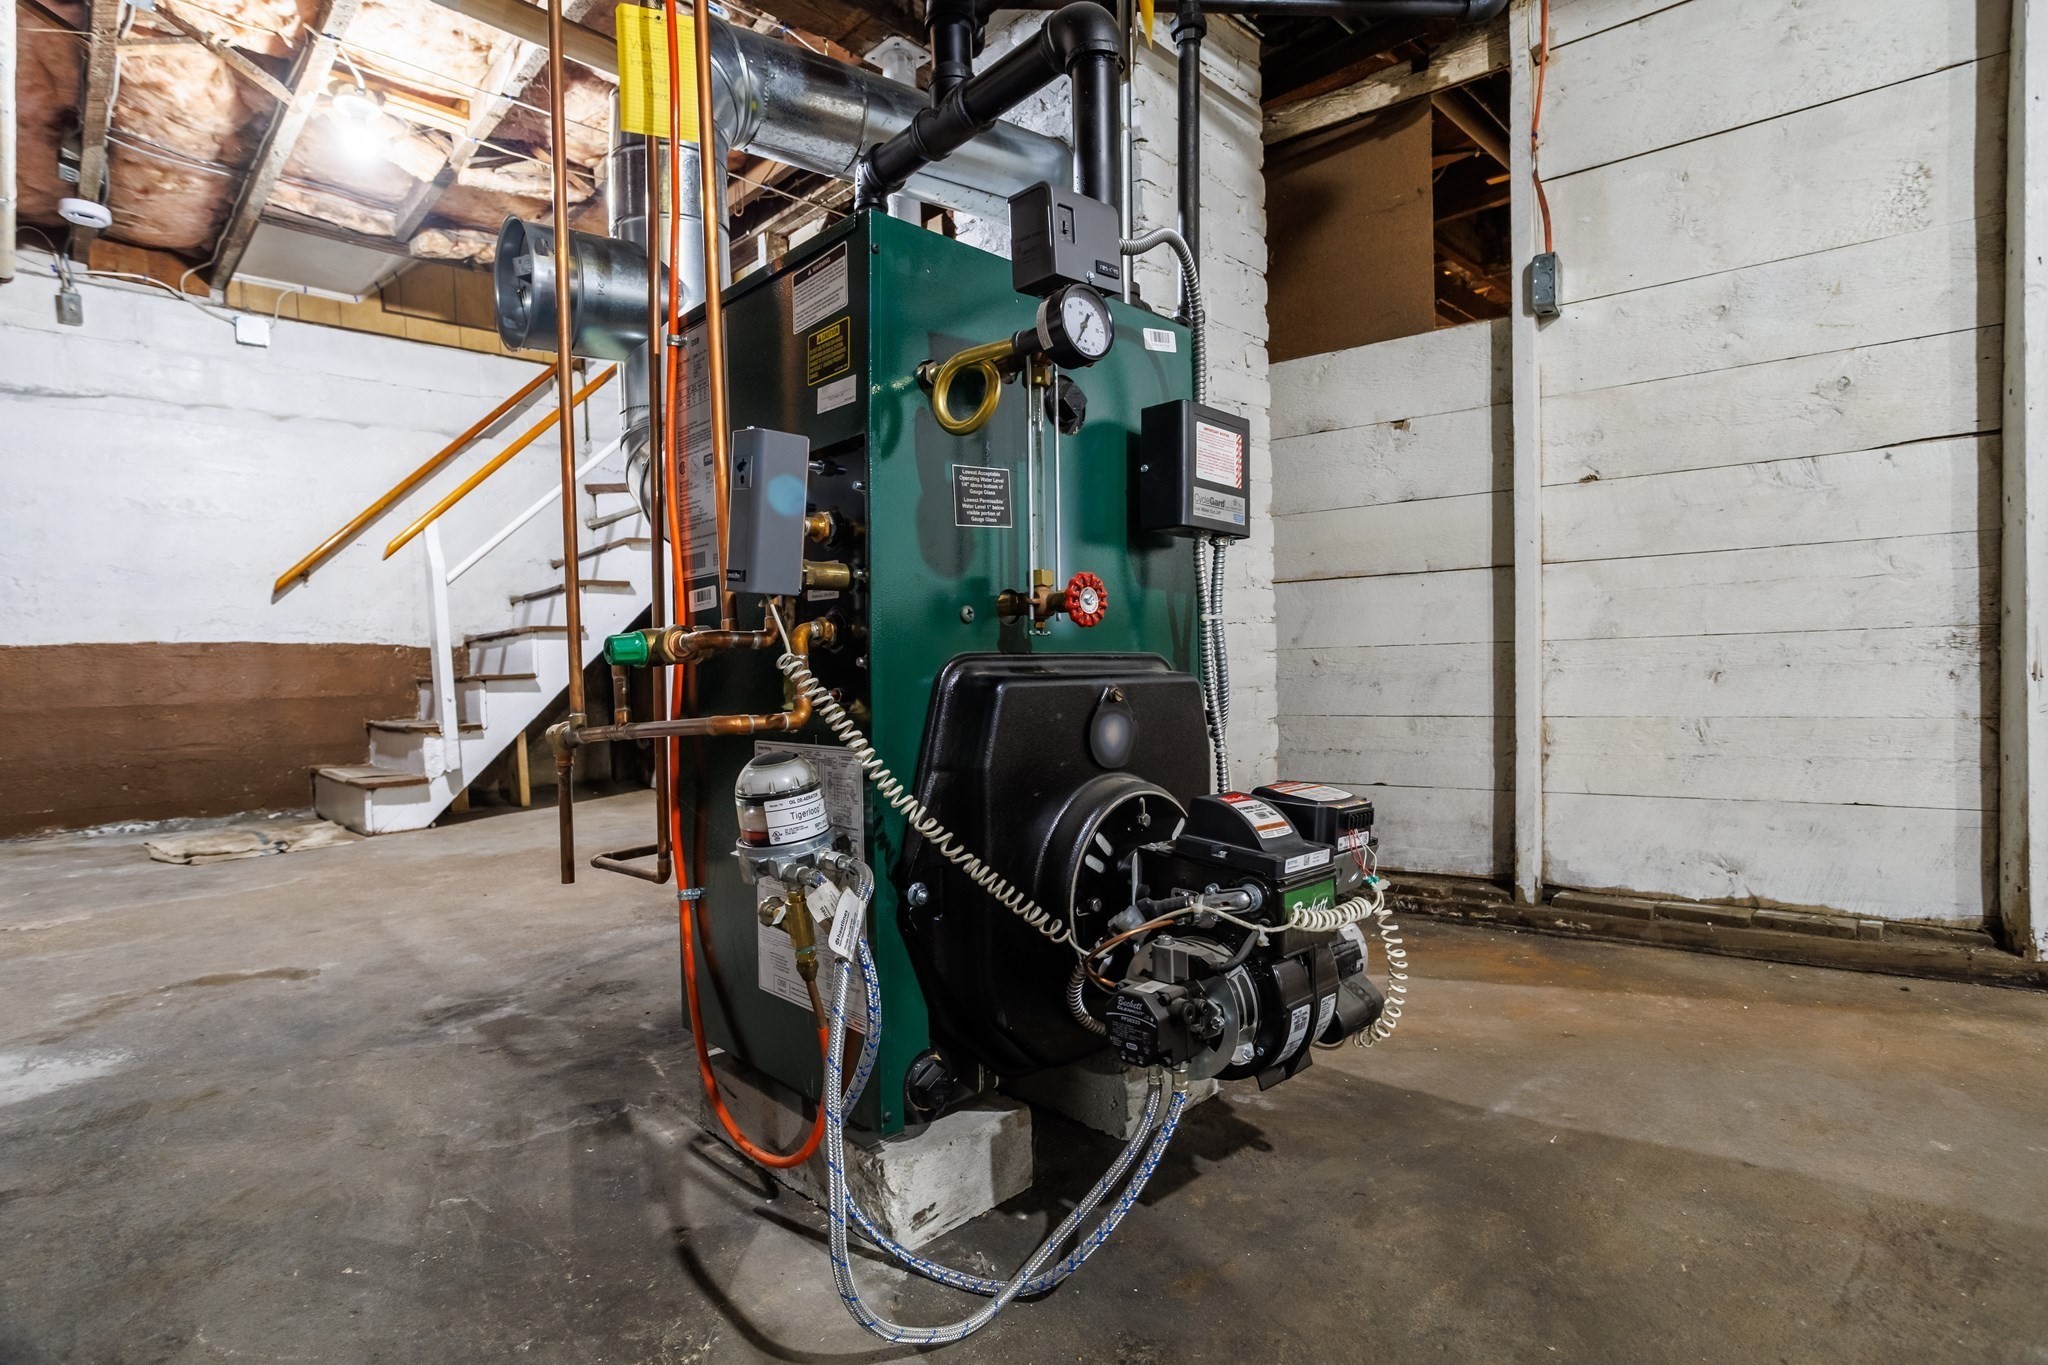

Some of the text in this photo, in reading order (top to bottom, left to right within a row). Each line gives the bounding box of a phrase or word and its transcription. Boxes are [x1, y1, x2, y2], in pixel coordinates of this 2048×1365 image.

[812, 257, 831, 272] WARNING
[822, 327, 839, 340] CAUTION
[790, 805, 820, 821] Tigerloop
[837, 910, 848, 939] heatlines
[1118, 996, 1143, 1010] Beckett
